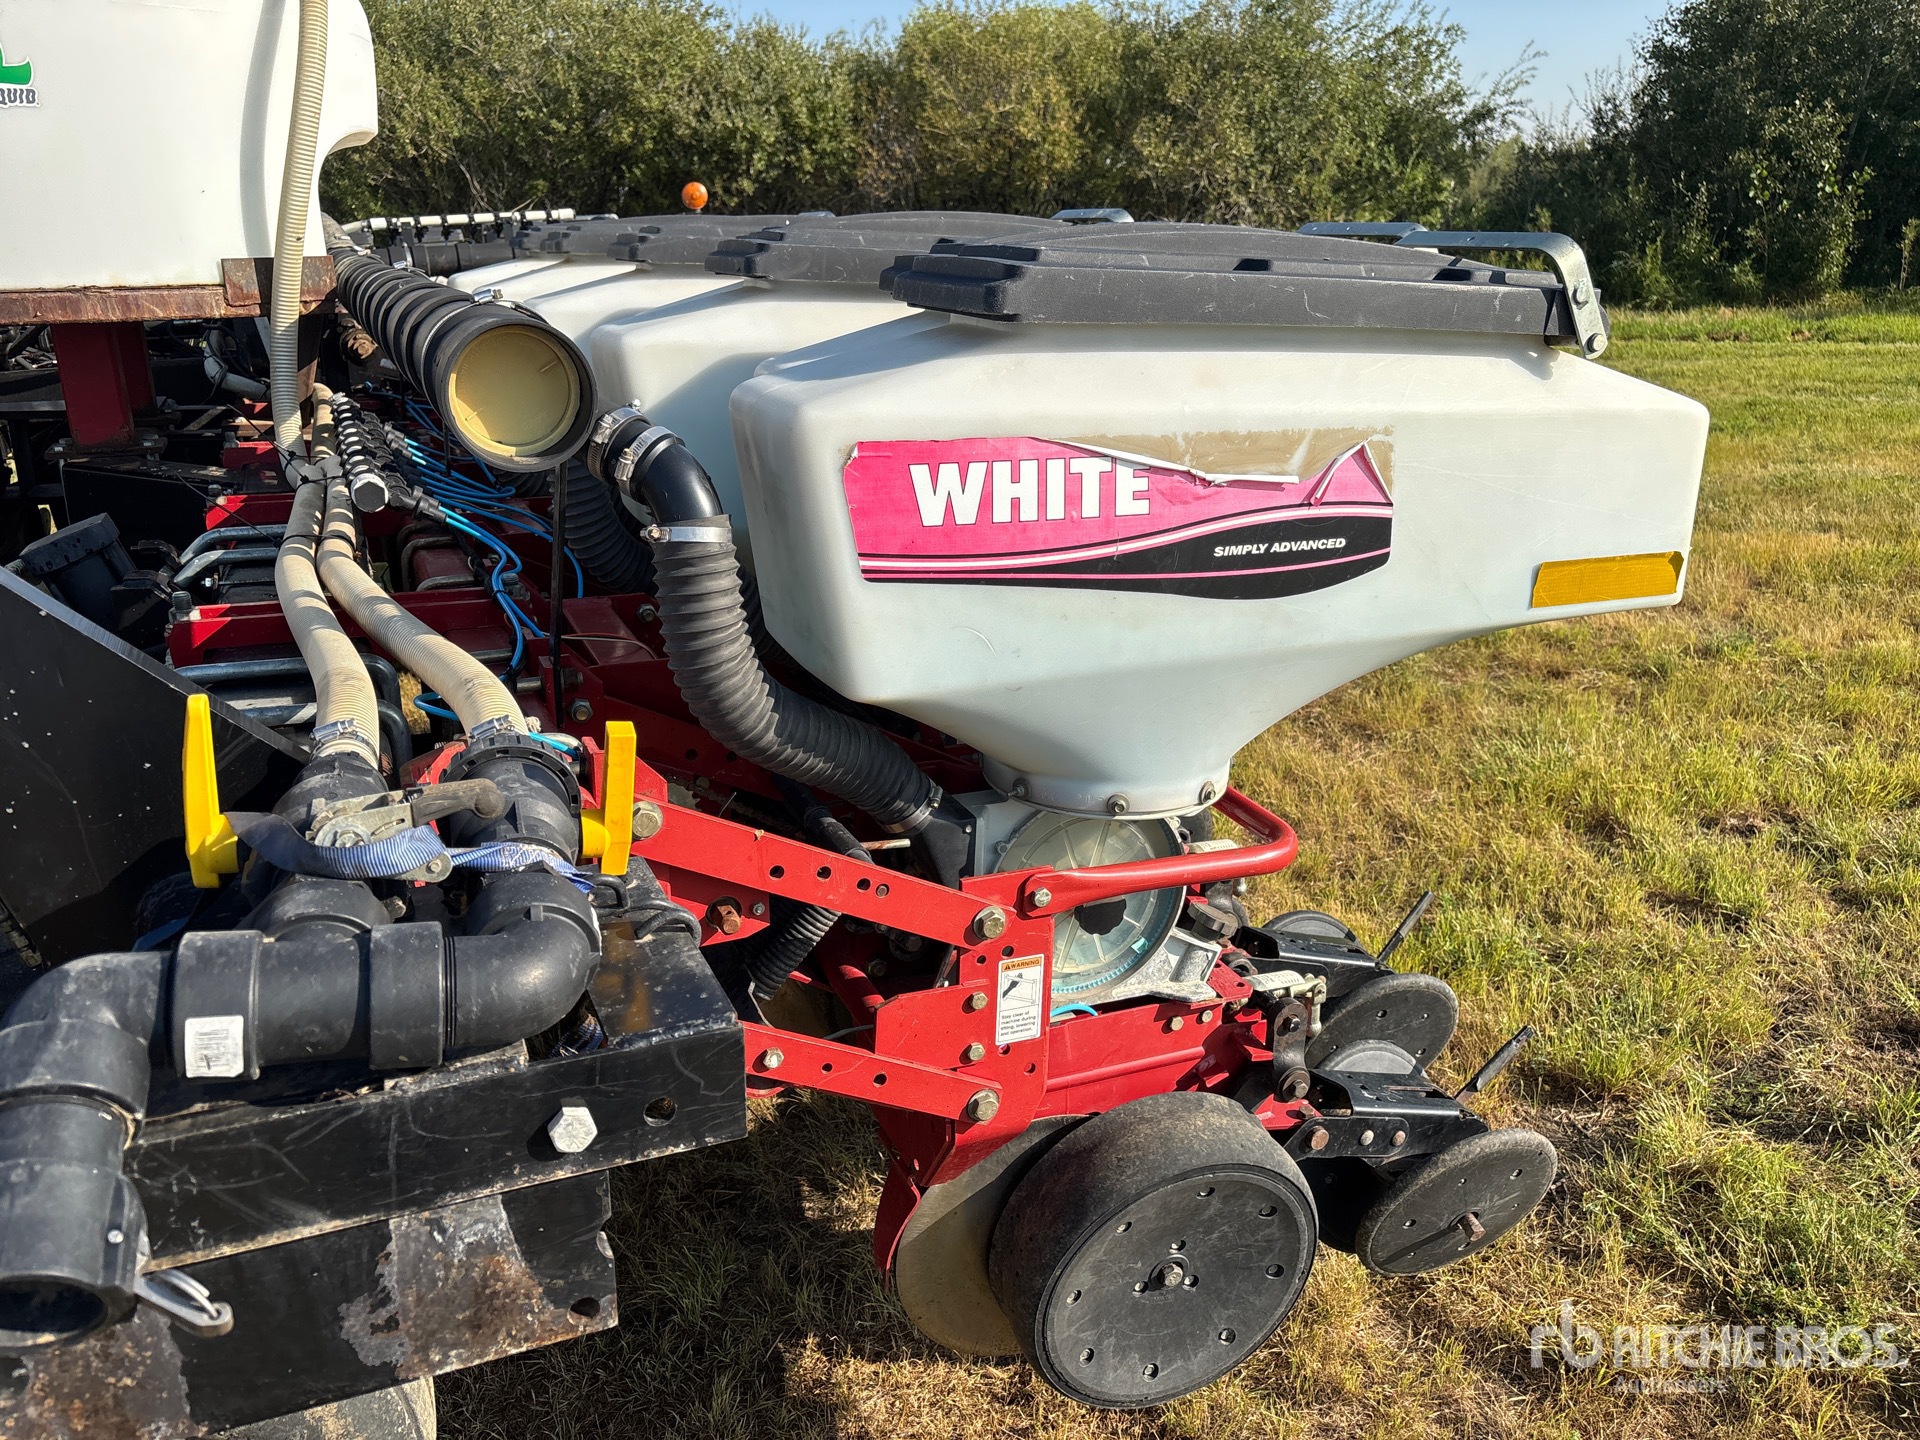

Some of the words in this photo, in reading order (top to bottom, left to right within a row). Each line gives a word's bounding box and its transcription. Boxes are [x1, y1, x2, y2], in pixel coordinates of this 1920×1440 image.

[908, 456, 1151, 527] WHITE
[1213, 543, 1268, 557] SIMPLY
[1270, 538, 1346, 553] ADVANCED
[1011, 959, 1039, 969] WARNING
